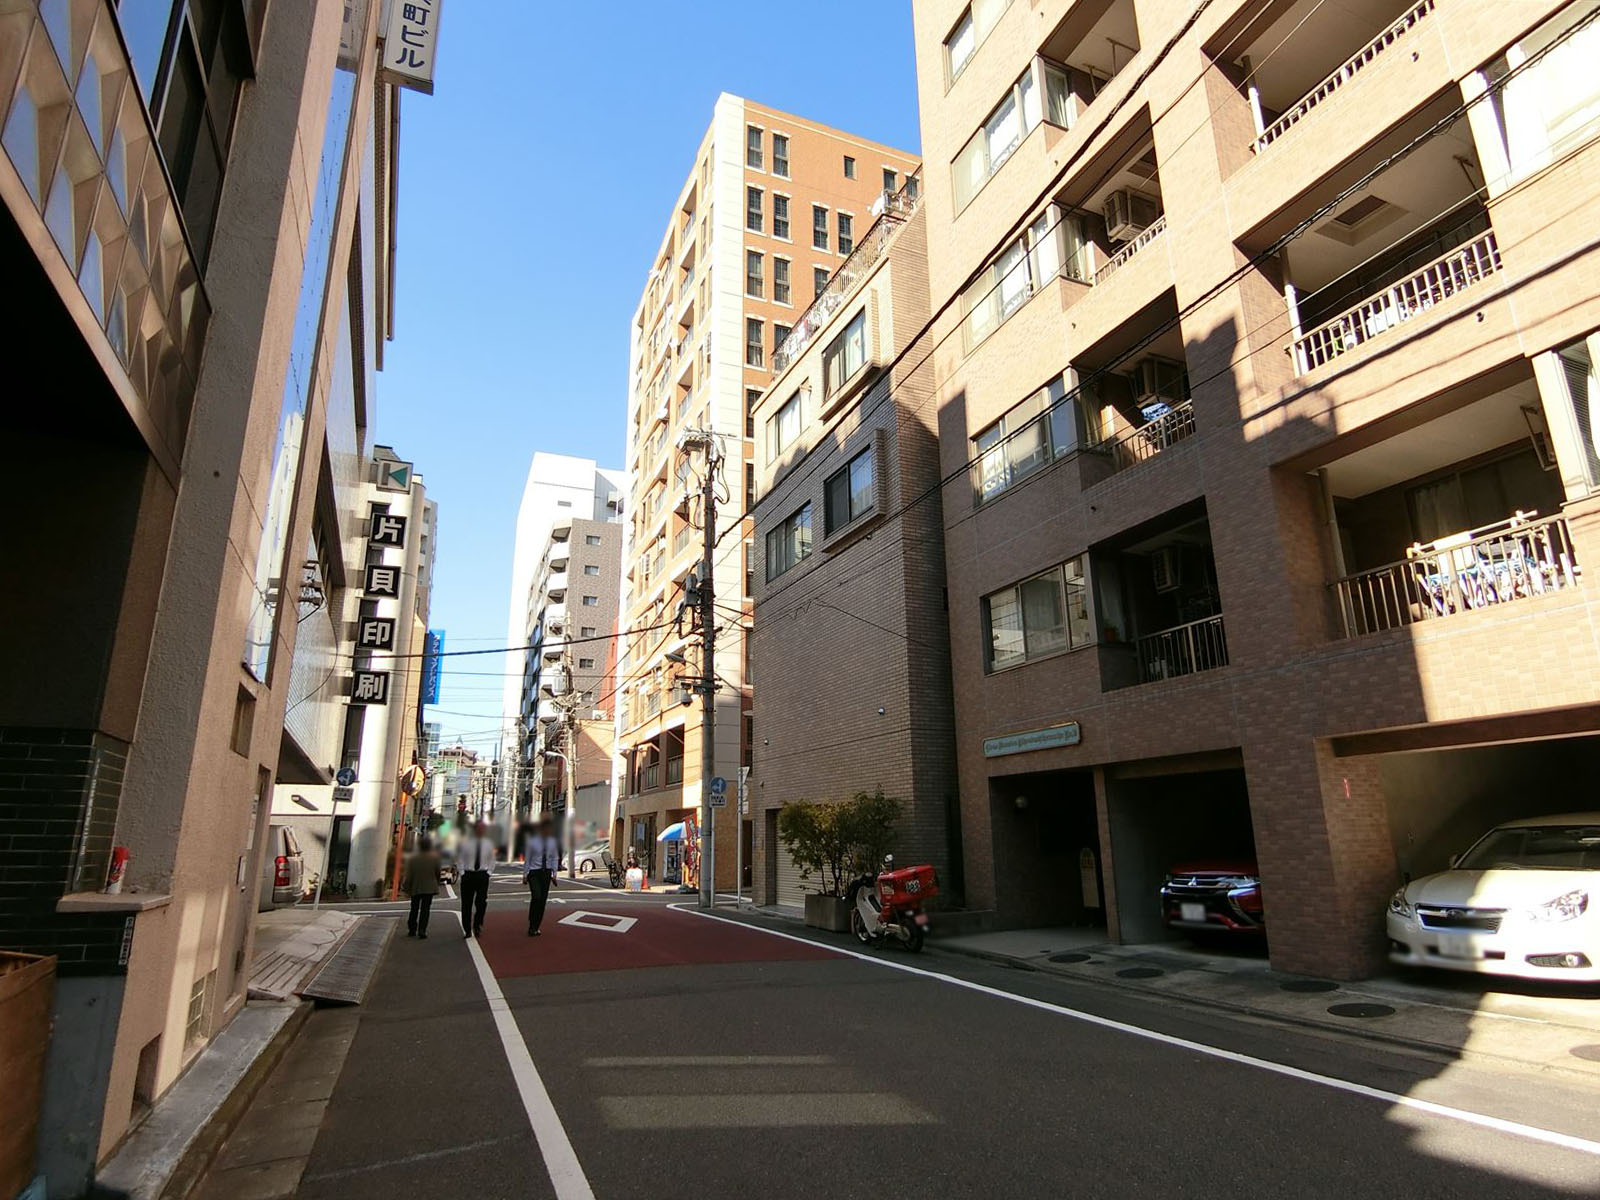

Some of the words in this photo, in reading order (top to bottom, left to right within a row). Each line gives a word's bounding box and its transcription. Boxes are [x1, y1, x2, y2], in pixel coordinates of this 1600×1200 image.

[395, 0, 432, 68] 町ビル
[355, 516, 402, 701] 片貝印刷
